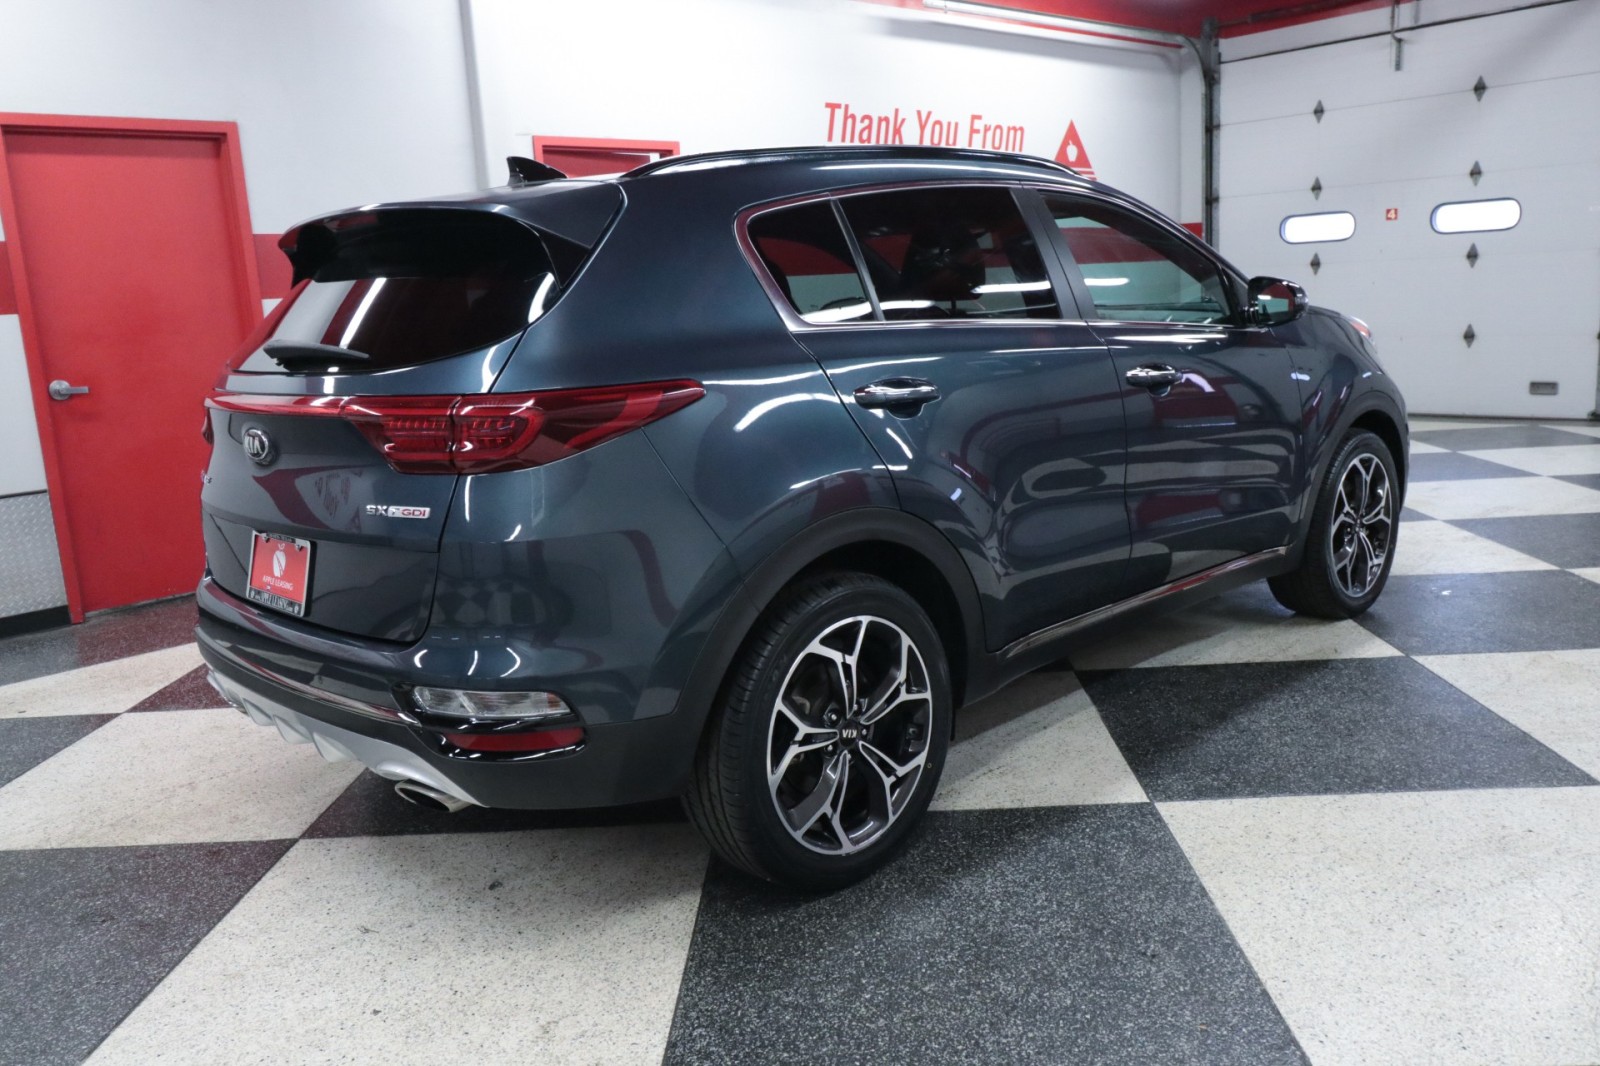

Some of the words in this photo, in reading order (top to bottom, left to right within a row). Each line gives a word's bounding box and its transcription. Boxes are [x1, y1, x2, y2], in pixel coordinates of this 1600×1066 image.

[825, 102, 906, 144] Thank
[916, 110, 959, 146] You
[968, 114, 1025, 152] From
[245, 436, 263, 453] KIA
[842, 728, 857, 738] KIA
